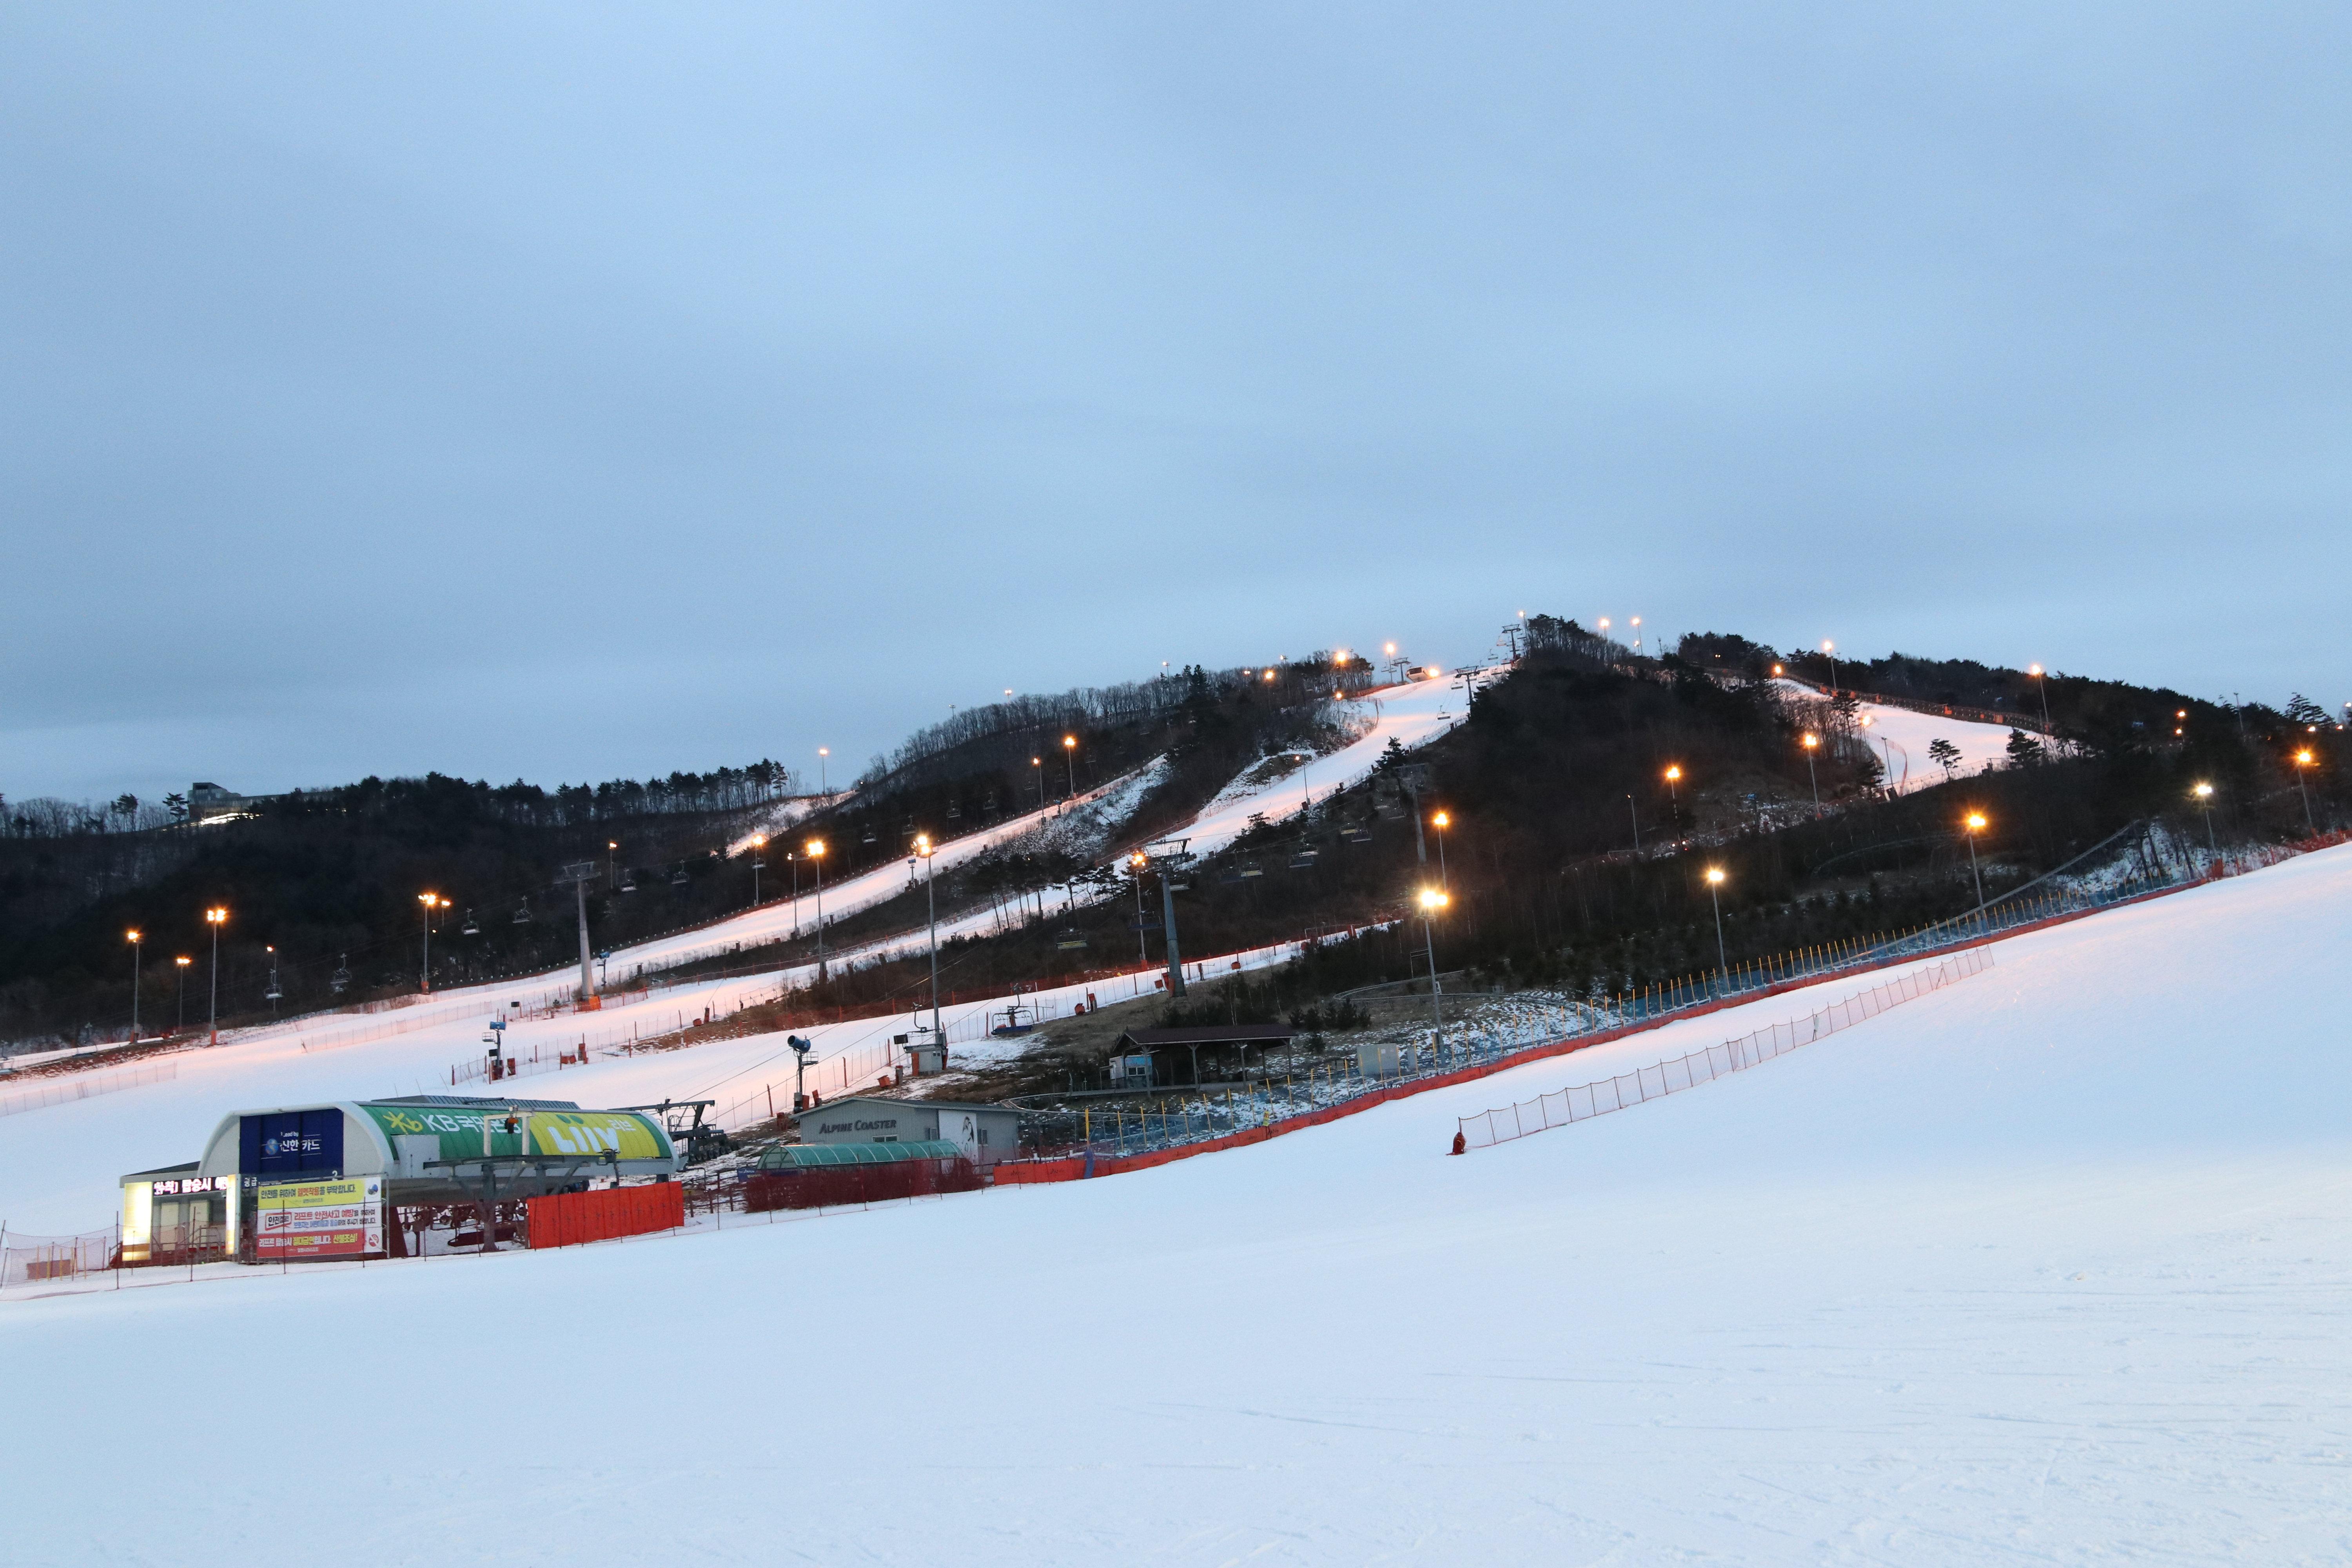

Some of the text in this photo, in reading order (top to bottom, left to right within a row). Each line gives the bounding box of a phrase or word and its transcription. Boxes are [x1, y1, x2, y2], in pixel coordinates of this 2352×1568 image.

[608, 1119, 636, 1131] 리브
[819, 1120, 897, 1134] ALPINE COASTER
[182, 1177, 212, 1194] 탑승시
[261, 1189, 278, 1199] 안전을
[279, 1188, 296, 1198] 위하여
[327, 1184, 356, 1194] 부탁합니다.
[294, 1211, 313, 1221] 리프트
[315, 1210, 340, 1220] 안전사고
[259, 1238, 275, 1247] 리프트
[276, 1237, 292, 1247] 탑승시
[333, 1233, 358, 1244] 산불조심!
